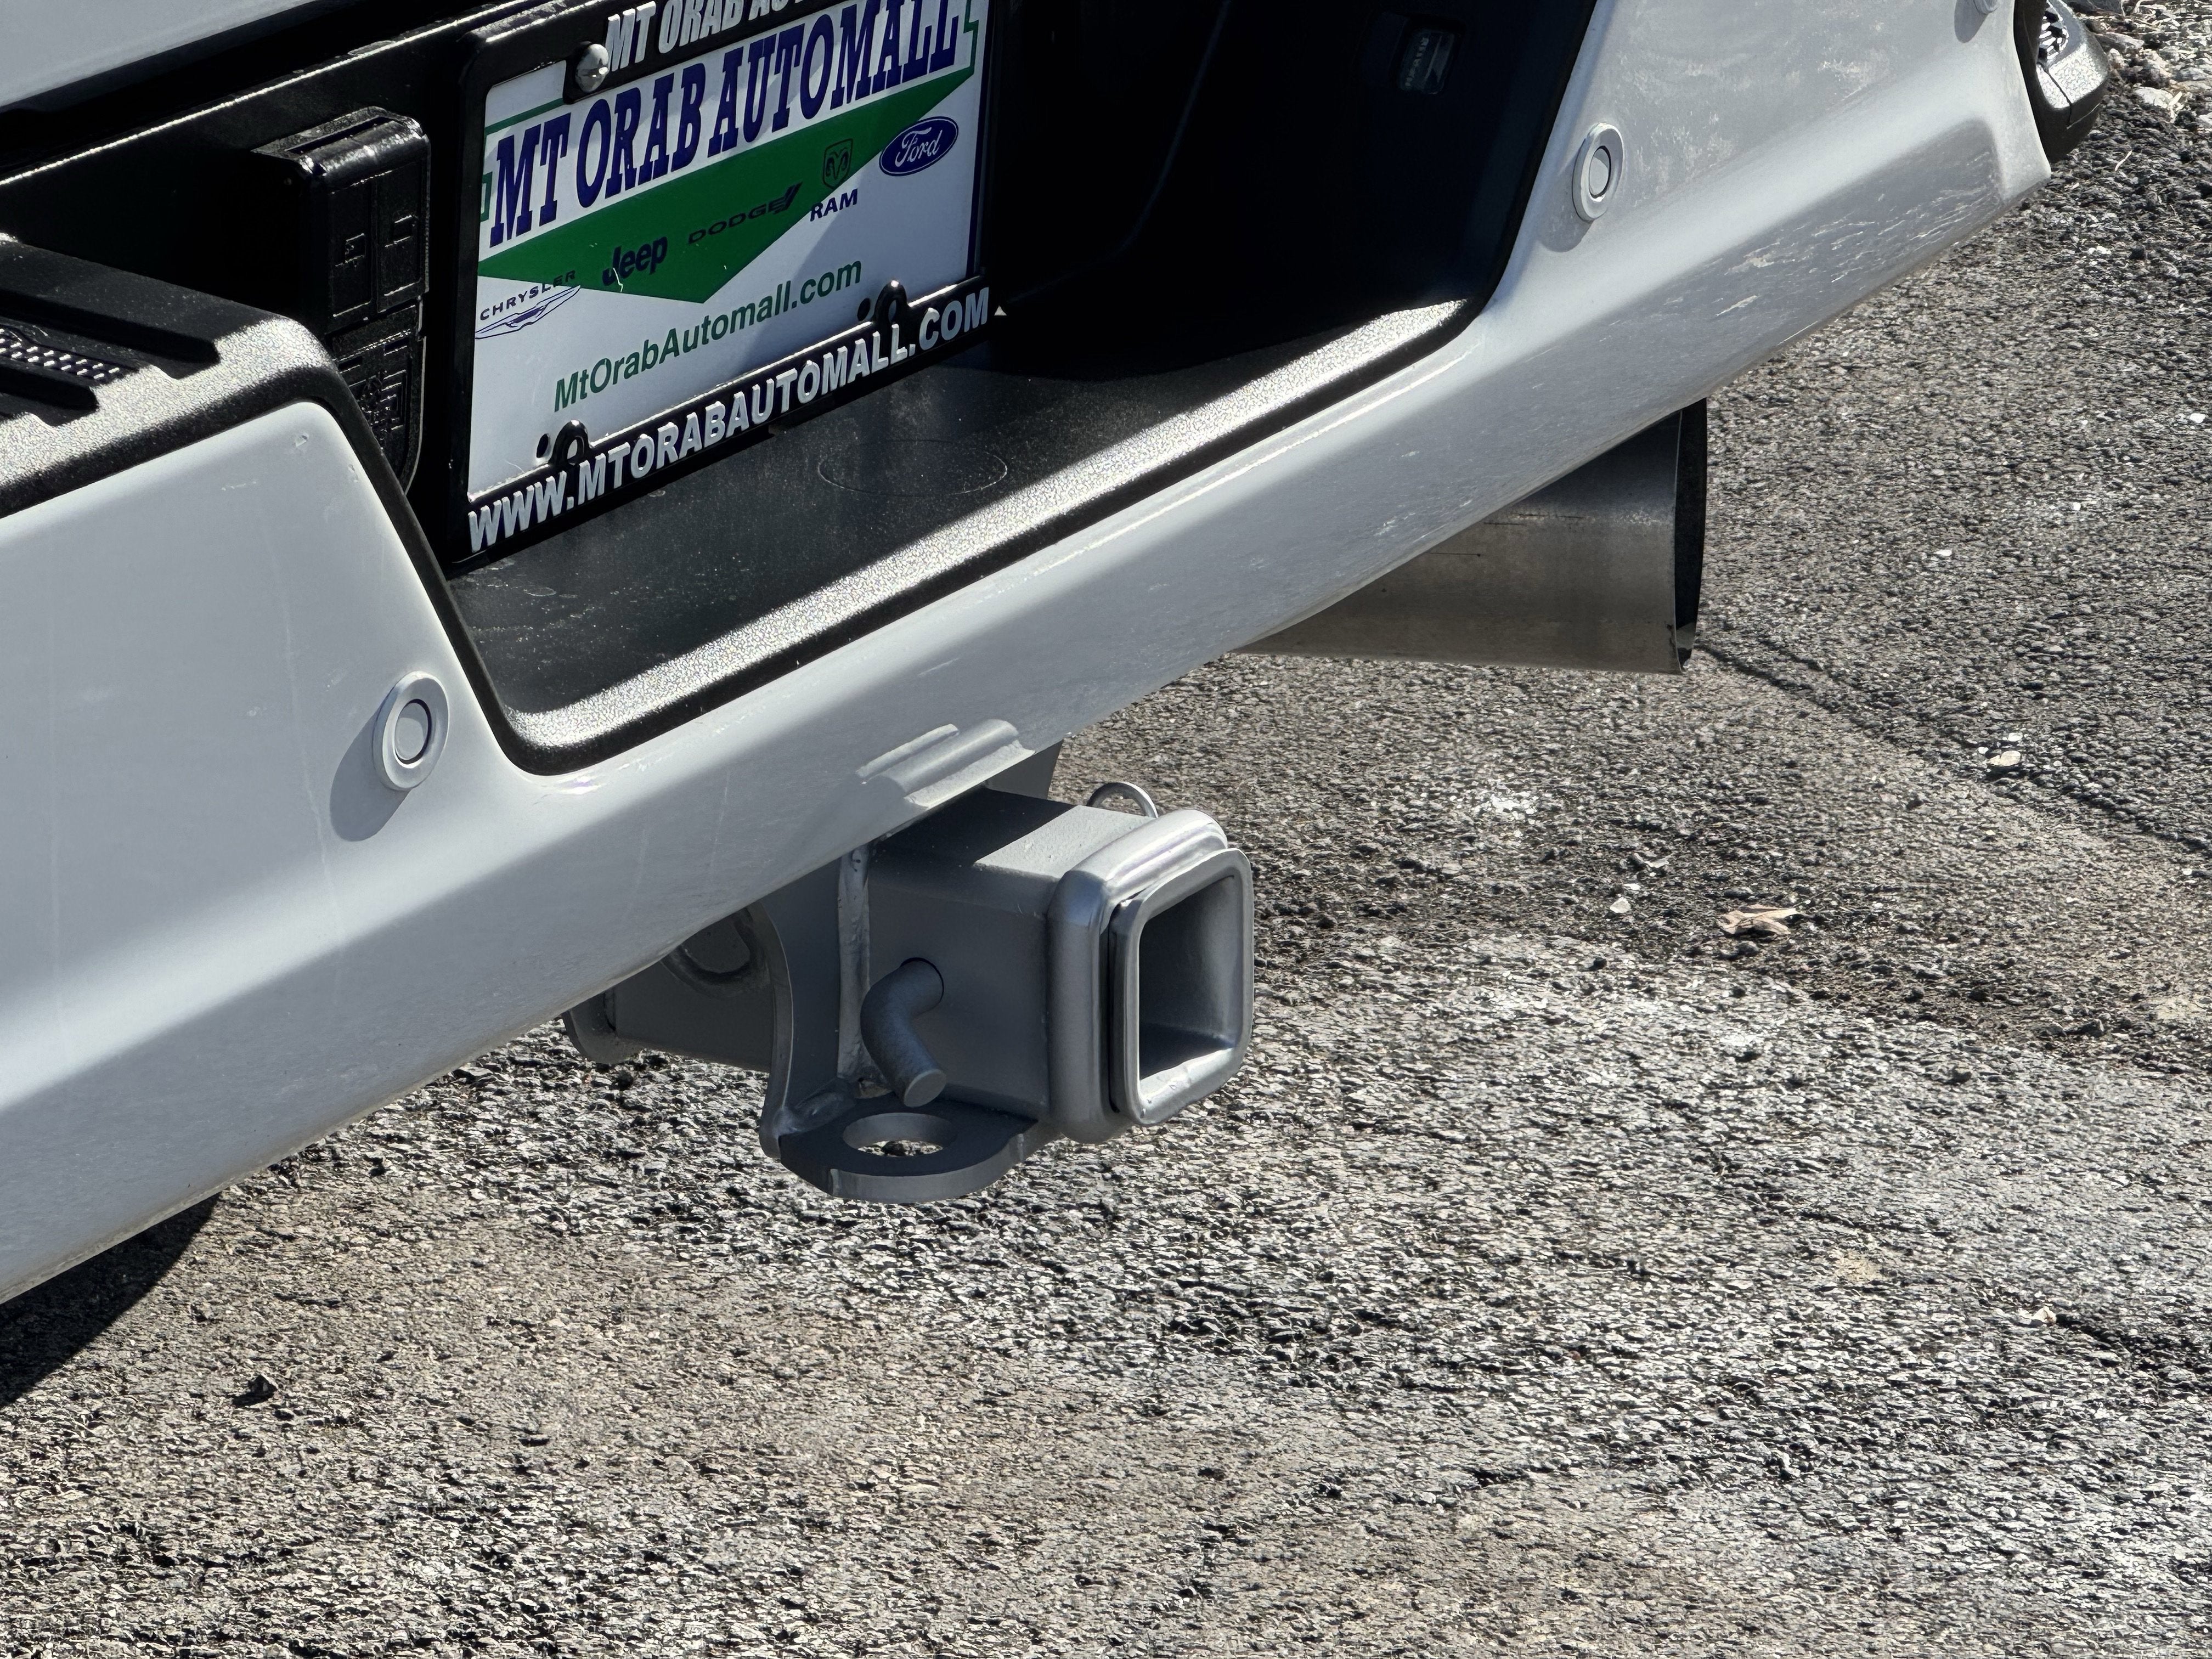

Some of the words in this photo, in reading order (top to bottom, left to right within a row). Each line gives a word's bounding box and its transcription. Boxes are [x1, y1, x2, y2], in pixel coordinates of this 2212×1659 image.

[605, 1, 656, 72] MT
[489, 112, 571, 248] MT
[576, 63, 706, 208] ORAB
[708, 0, 960, 158] AUTOMALL
[895, 127, 943, 167] Ford
[688, 198, 789, 245] DODGE
[810, 188, 858, 222] RAM
[602, 236, 668, 286] Jeep
[480, 270, 576, 321] CHRYSLER
[554, 260, 861, 411] MtOrabAutomall.com
[467, 286, 989, 554] WWW.MTORABAUTOMALL.COM
